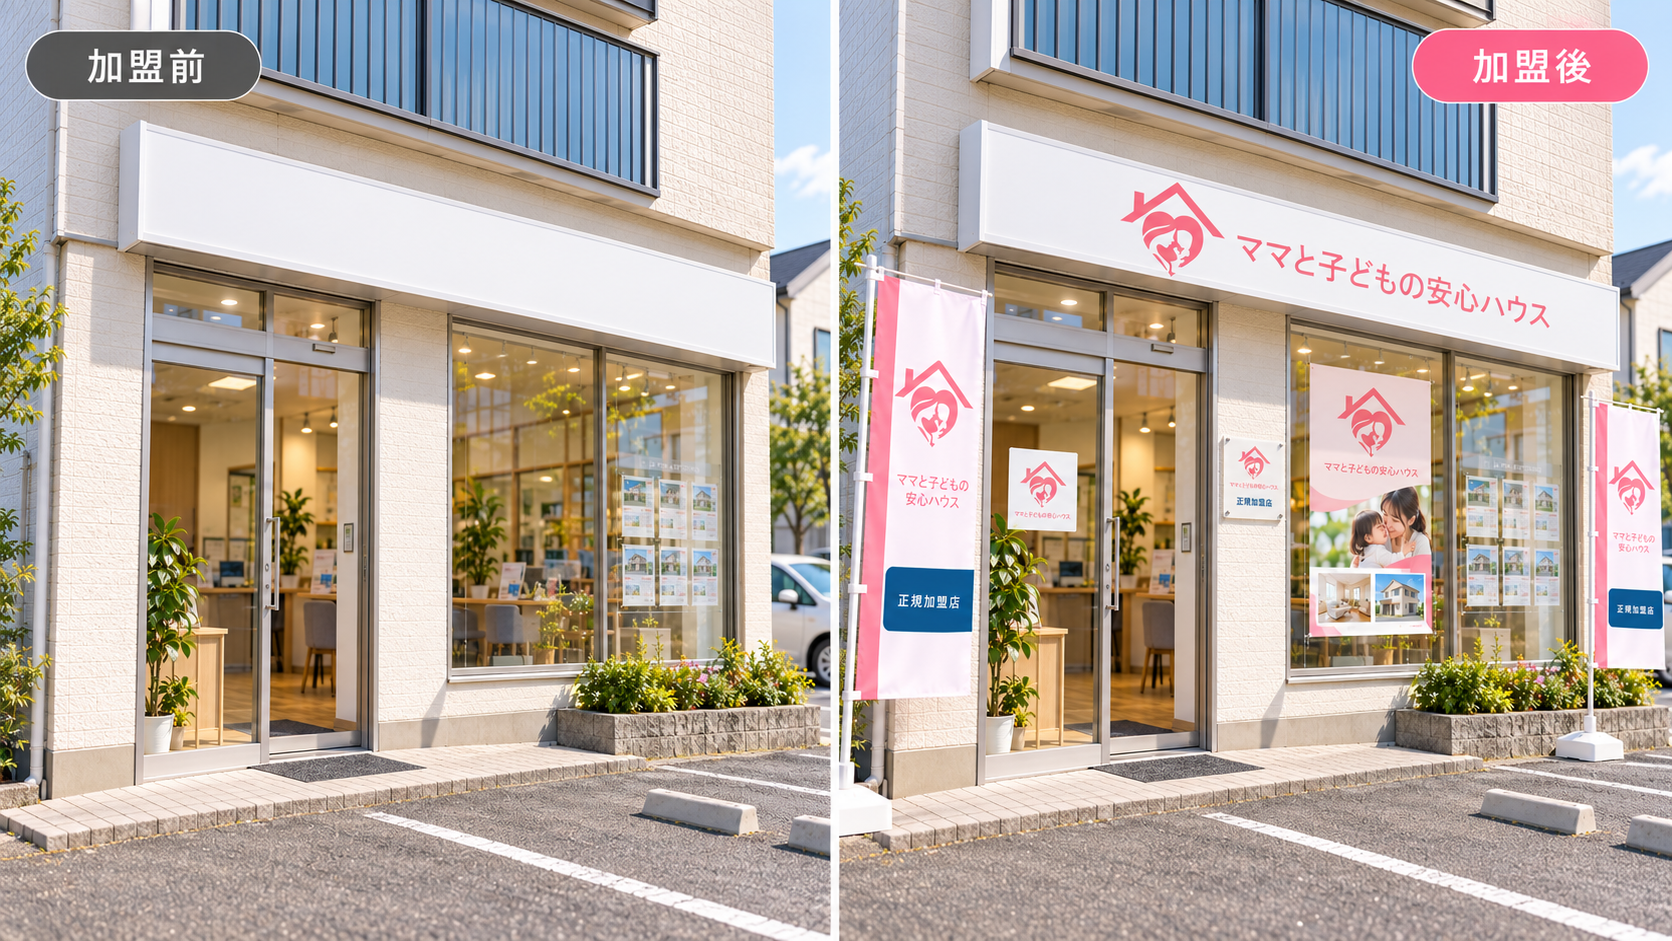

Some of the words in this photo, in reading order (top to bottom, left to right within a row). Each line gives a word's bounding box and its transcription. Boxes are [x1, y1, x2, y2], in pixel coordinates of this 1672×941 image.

[1237, 234, 1550, 328] ママと子どもの安心ハウス
[1324, 462, 1419, 478] ママと子どもの安心ハウス
[896, 473, 969, 492] ママと子どもの
[905, 491, 959, 509] 安心ハウス
[1613, 531, 1656, 543] ママと子どもの
[897, 593, 961, 609] 正規加盟店
